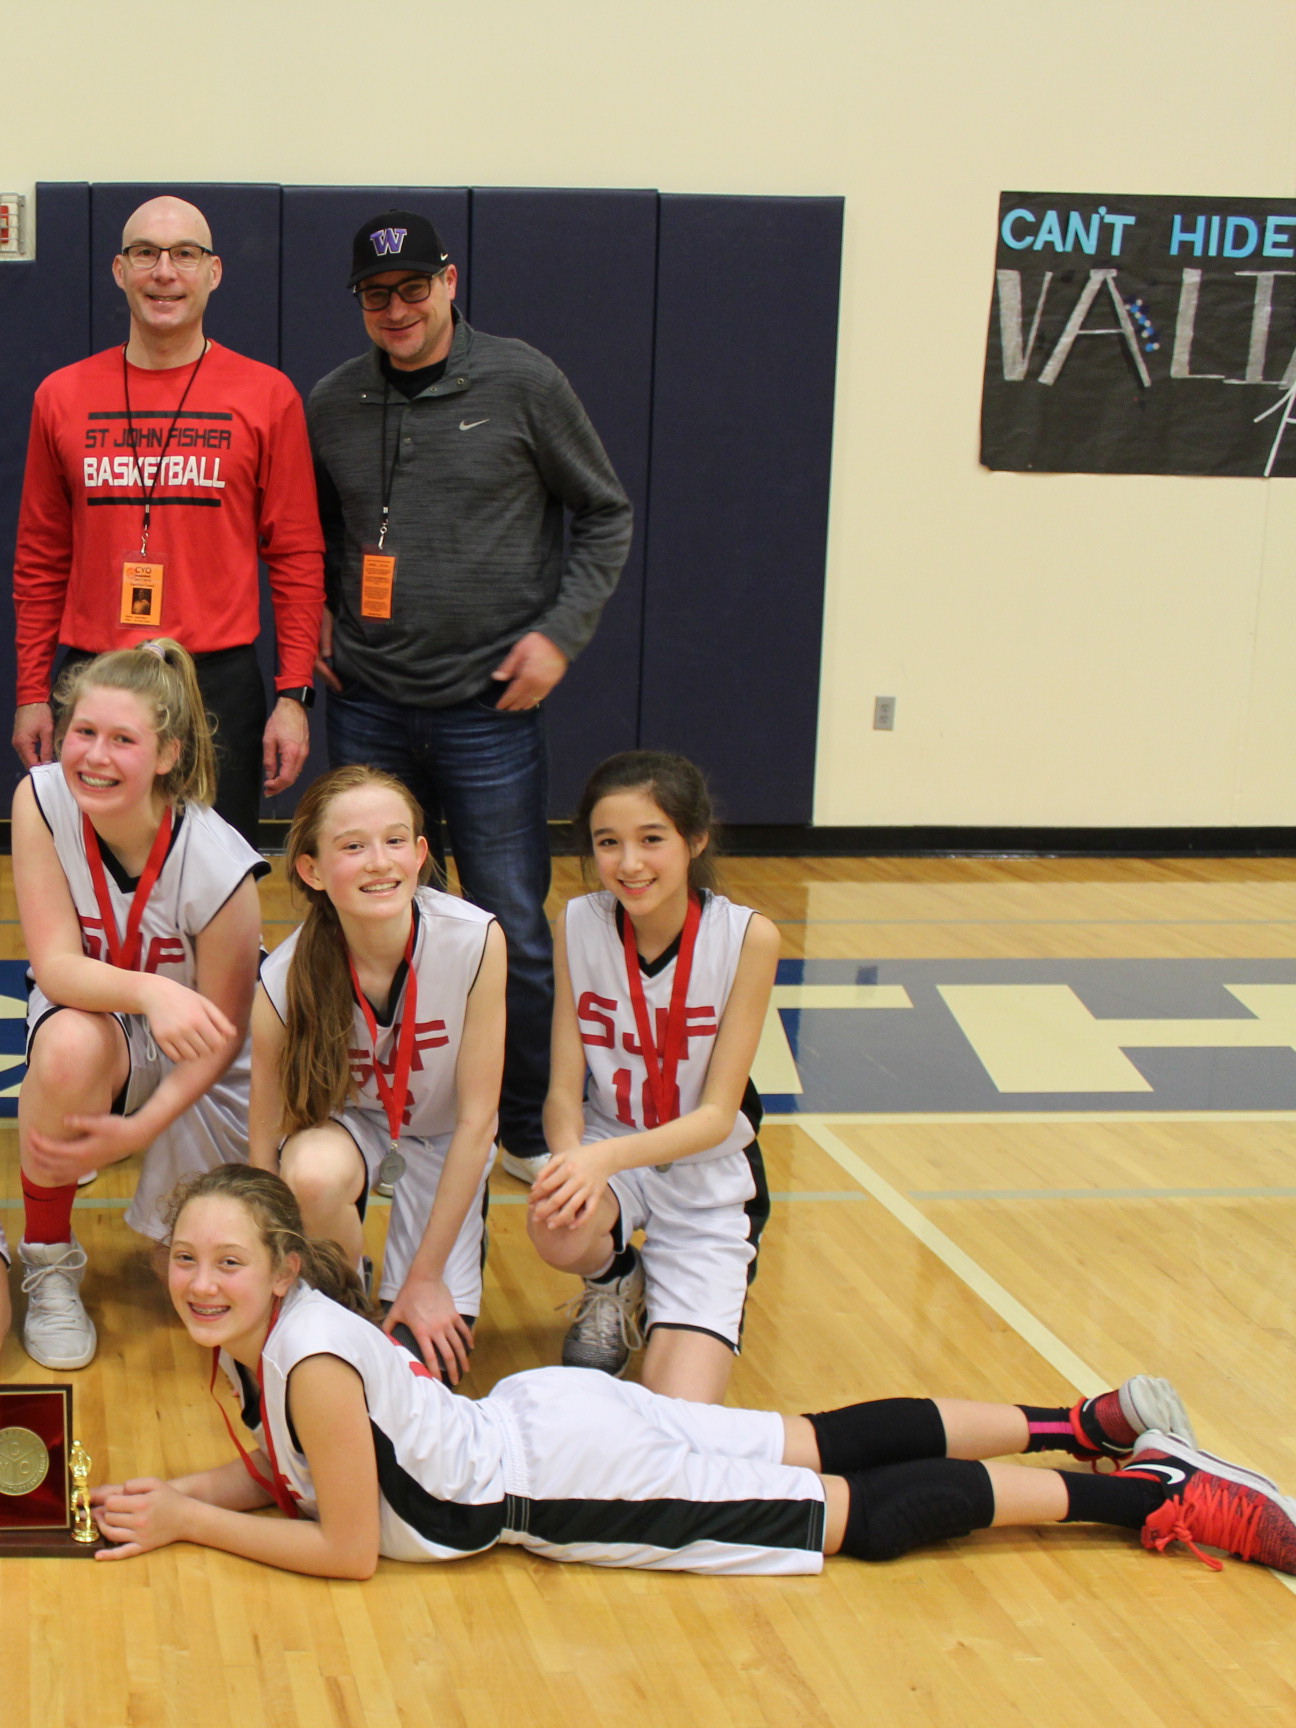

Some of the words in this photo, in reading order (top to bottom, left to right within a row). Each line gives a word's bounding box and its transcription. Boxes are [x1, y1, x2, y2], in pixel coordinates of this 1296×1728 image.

[370, 227, 408, 257] W
[1001, 206, 1136, 257] CAN'T
[1169, 214, 1296, 258] HIDE
[996, 267, 1296, 389] VALI
[84, 429, 110, 448] ST
[113, 427, 163, 448] JOHN
[165, 427, 233, 450] FISHER
[83, 455, 227, 489] BASKETBALL
